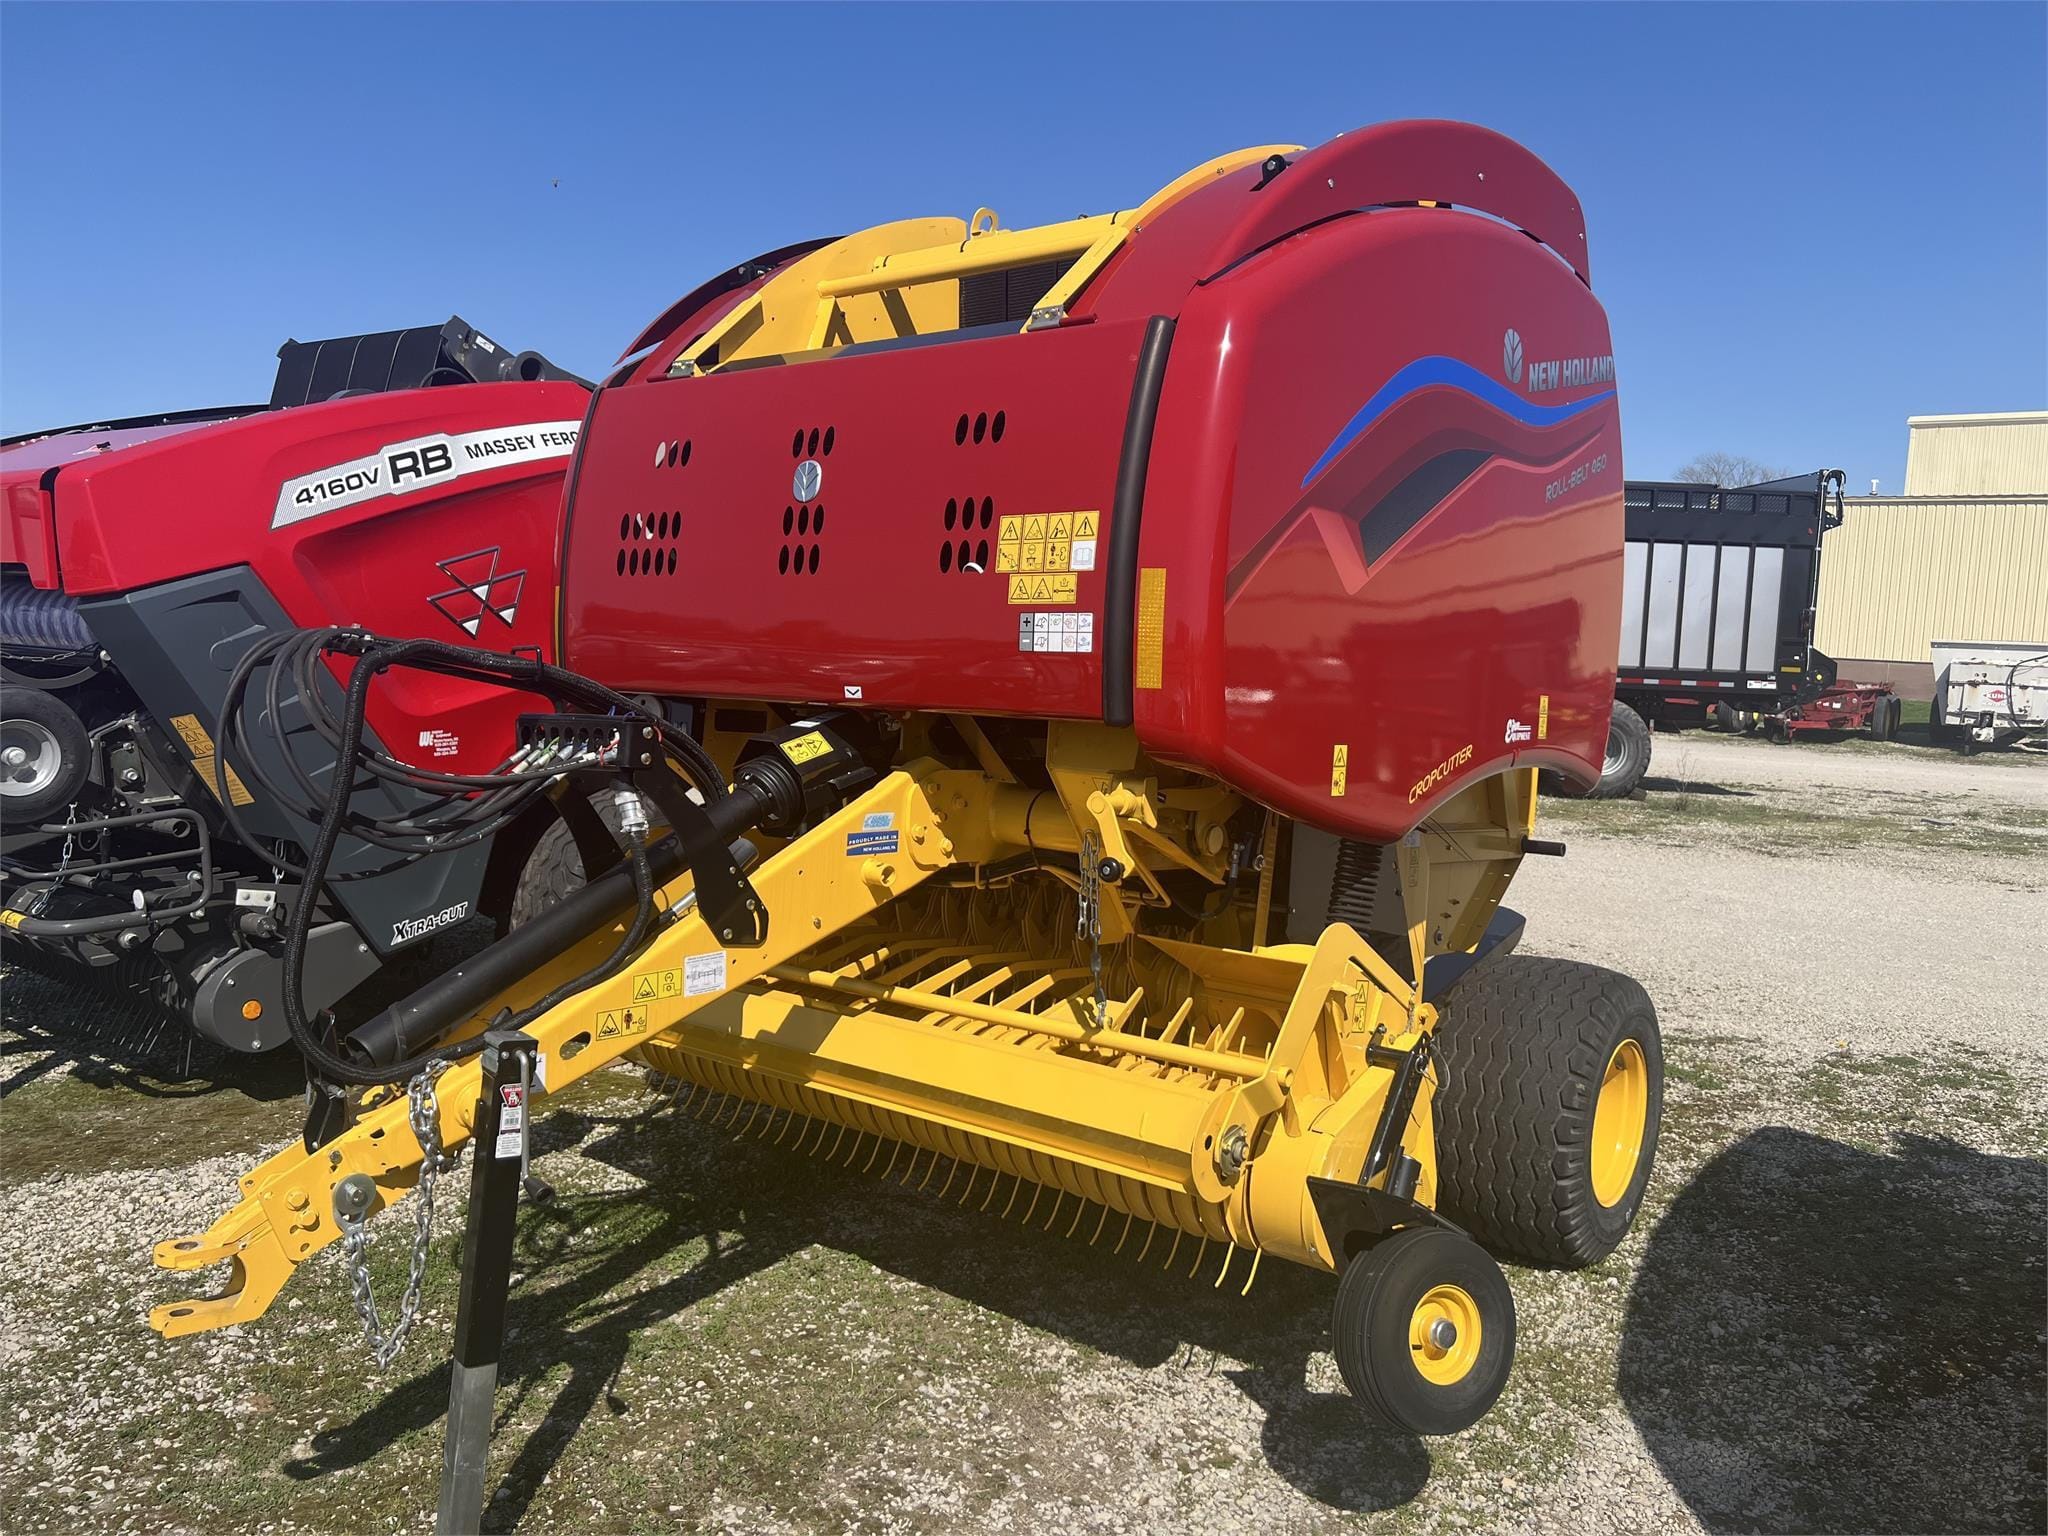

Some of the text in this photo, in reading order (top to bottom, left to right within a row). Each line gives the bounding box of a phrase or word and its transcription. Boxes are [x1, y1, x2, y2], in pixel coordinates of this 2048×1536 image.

[1529, 355, 1616, 393] NEW HOLLAND
[295, 467, 379, 504] 4160V
[388, 443, 453, 485] RB
[464, 435, 536, 459] MASSEY
[1408, 744, 1473, 804] CROPCUTTER
[848, 837, 873, 845] PROUDLY
[390, 901, 468, 946] XTRA-CUT
